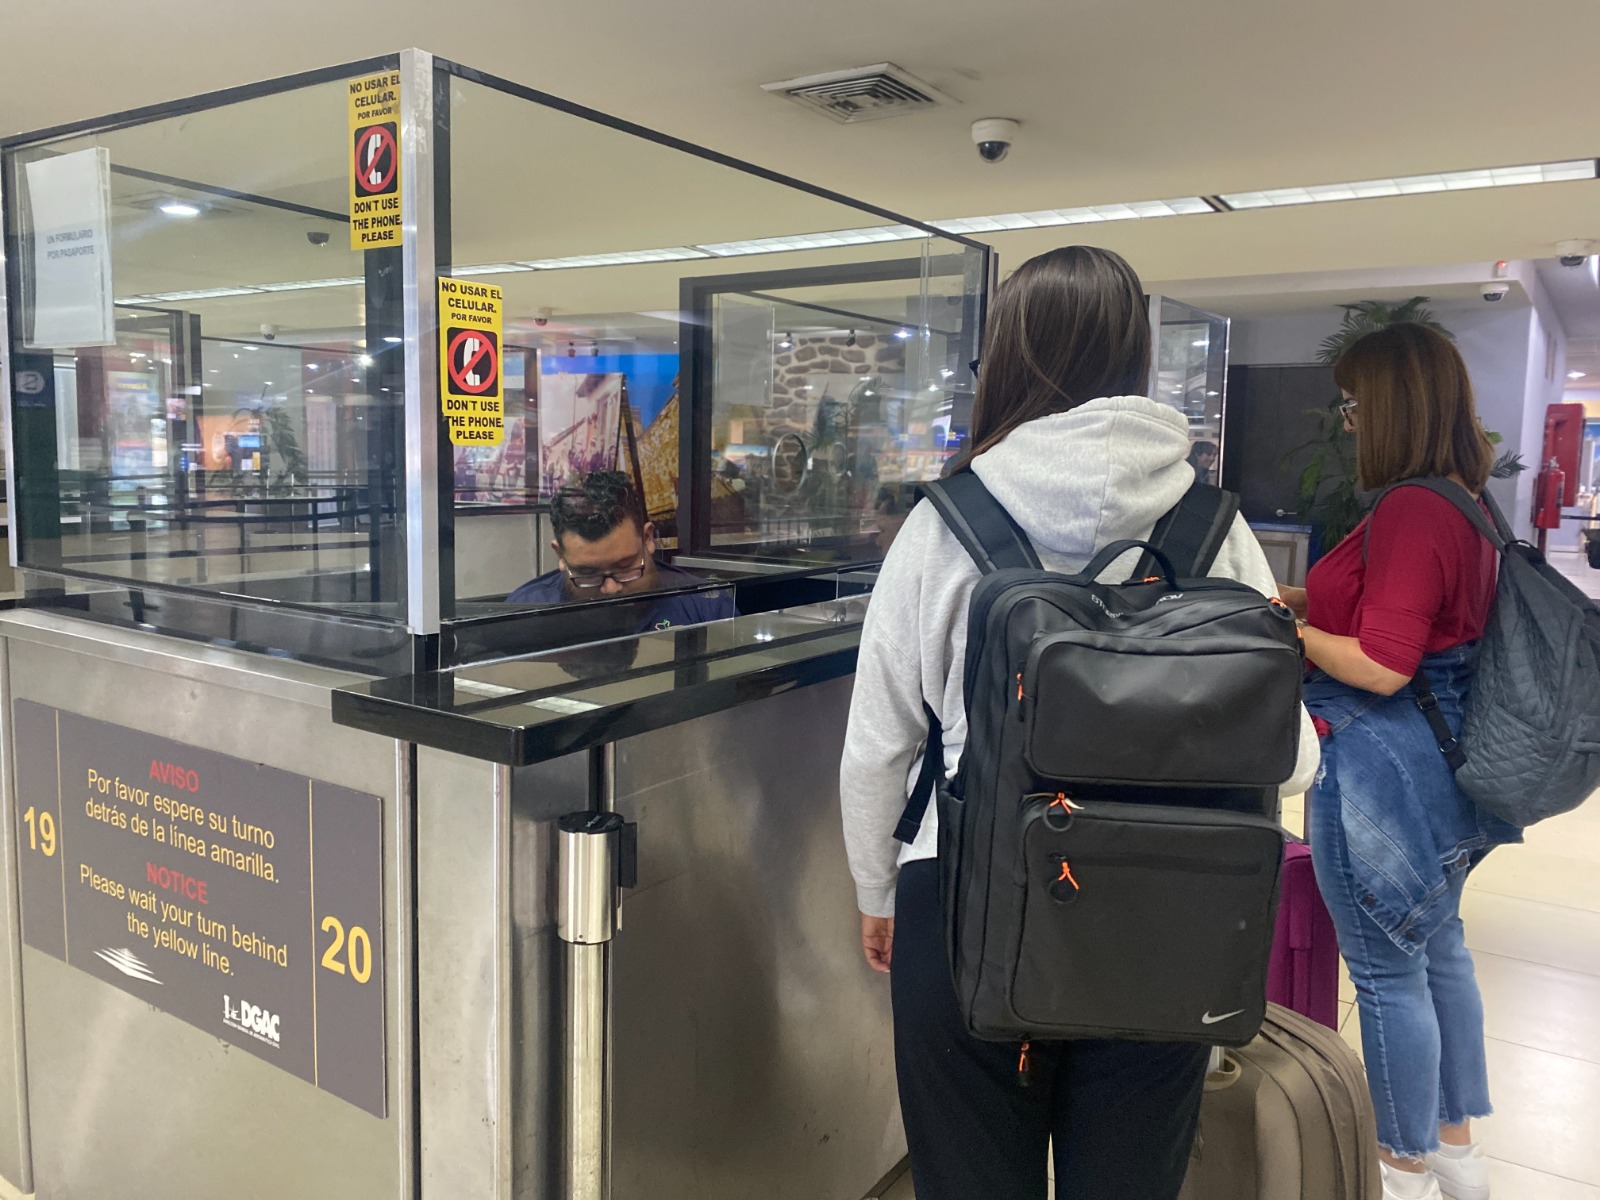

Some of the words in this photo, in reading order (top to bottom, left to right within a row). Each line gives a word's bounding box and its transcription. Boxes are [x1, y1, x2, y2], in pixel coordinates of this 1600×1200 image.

[350, 83, 362, 94] NO
[364, 78, 388, 90] USAR
[390, 75, 400, 86] EL
[355, 91, 397, 108] CELULAR.
[358, 110, 371, 120] POR
[371, 107, 392, 118] FAVOR
[381, 197, 399, 209] USE
[353, 218, 369, 230] THE
[371, 214, 403, 228] PHONE.
[361, 230, 394, 243] PLEASE
[441, 282, 457, 293] NO
[460, 285, 488, 298] USAR
[490, 289, 503, 300] EL
[448, 298, 497, 313] CELULAR.
[451, 312, 467, 322] POR
[468, 314, 492, 324] FAVOR
[480, 401, 499, 412] USE
[468, 416, 504, 428] PHONE.
[456, 430, 494, 440] PLEASE
[149, 760, 200, 793] AVISO
[88, 768, 111, 795] Por
[114, 777, 150, 808] favor
[153, 795, 204, 826] espere
[208, 812, 227, 834] su
[232, 814, 275, 849] turno
[23, 806, 56, 857] 19
[85, 797, 127, 829] detrás
[130, 813, 149, 837] de
[152, 818, 165, 843] la
[169, 824, 206, 857] línea
[210, 844, 279, 884] amarilla.
[146, 862, 208, 905] NOTICE
[80, 863, 125, 900] Please
[128, 888, 157, 914] wait
[160, 900, 193, 928] your
[197, 911, 227, 942] turn
[231, 924, 287, 968] behind
[127, 911, 149, 938] the
[153, 927, 199, 960] yellow
[202, 942, 234, 977] line.
[321, 916, 372, 984] 20
[241, 1000, 280, 1042] DGAC
